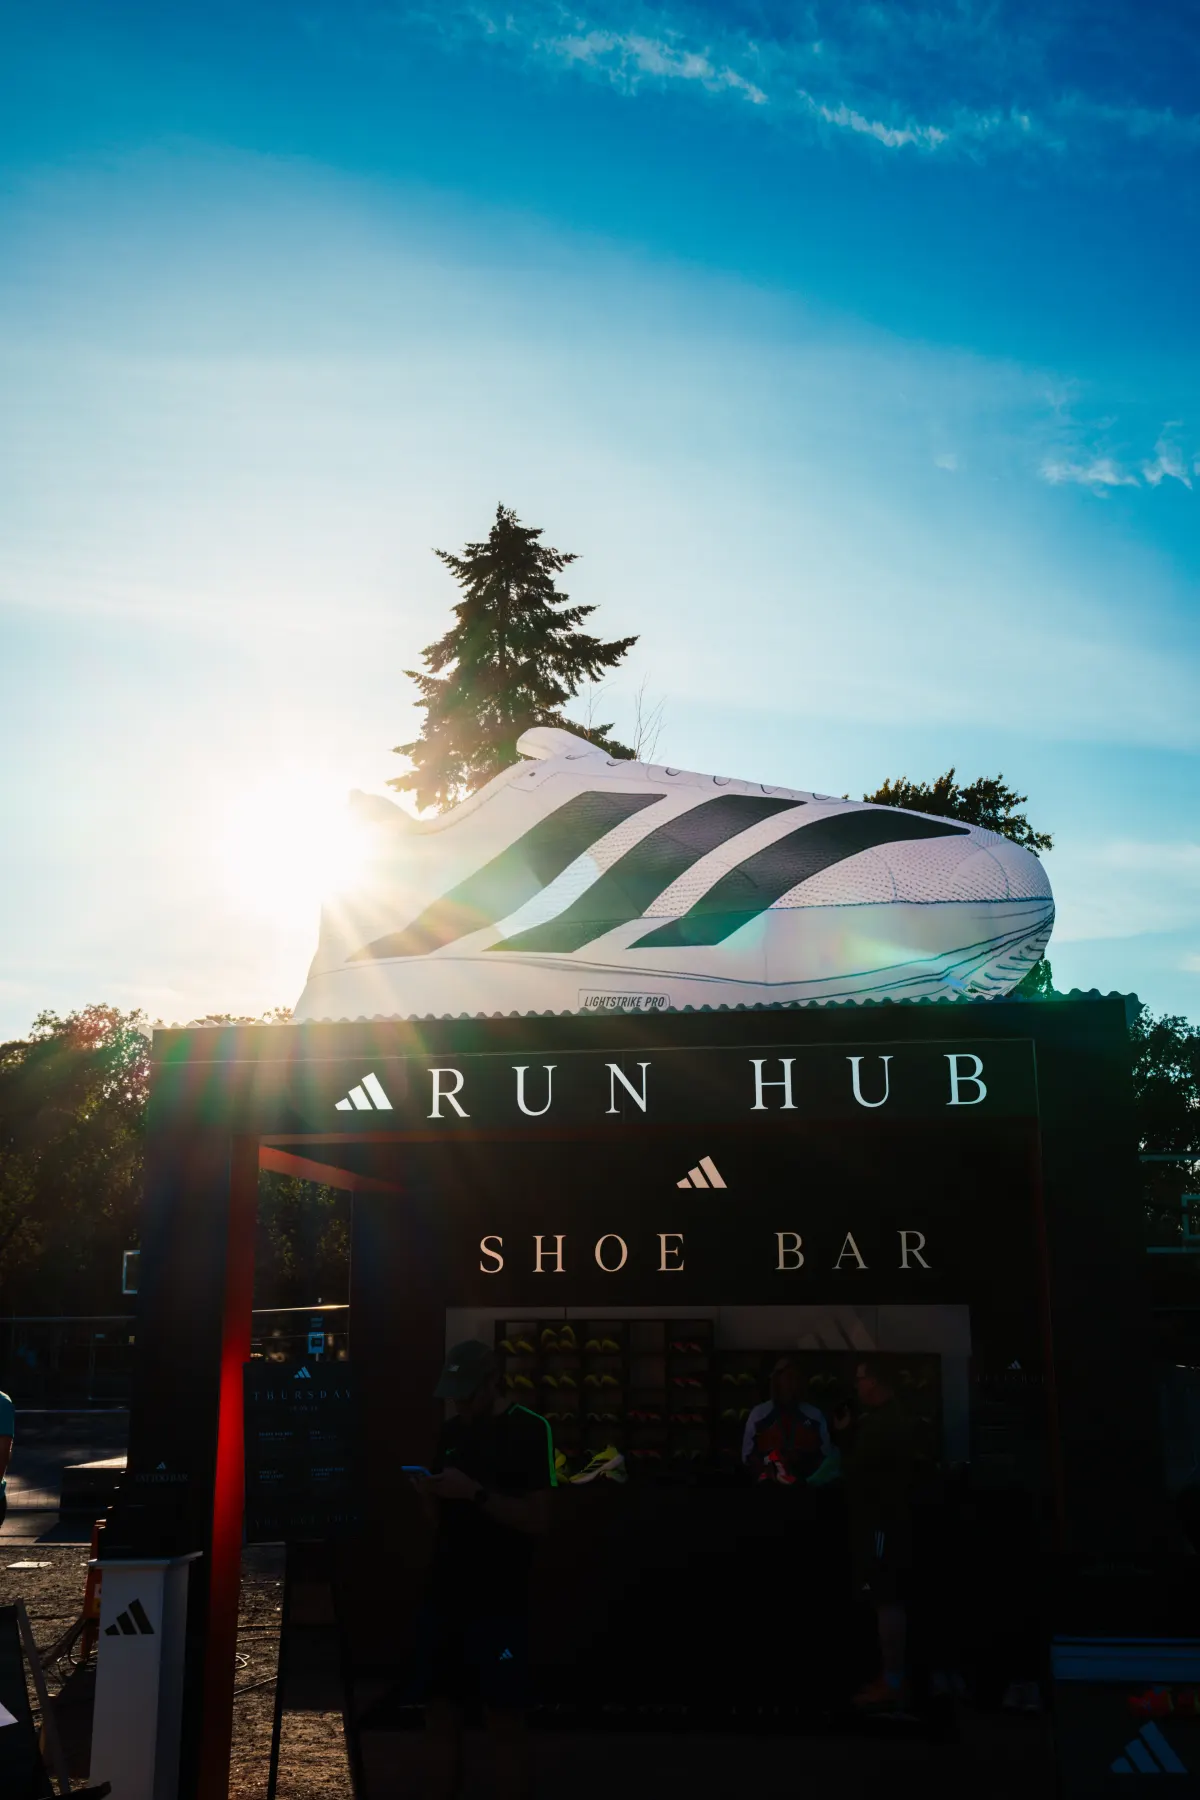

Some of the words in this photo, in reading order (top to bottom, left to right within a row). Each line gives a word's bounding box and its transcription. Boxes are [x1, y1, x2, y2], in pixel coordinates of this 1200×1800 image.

[584, 996, 642, 1007] LIGHTSTRIKE
[645, 996, 665, 1007] PRO
[427, 1063, 651, 1119] RUN
[749, 1053, 988, 1110] HUB
[478, 1233, 686, 1275] SHOE
[775, 1230, 931, 1271] BAR
[252, 1389, 353, 1401] THURSDAY
